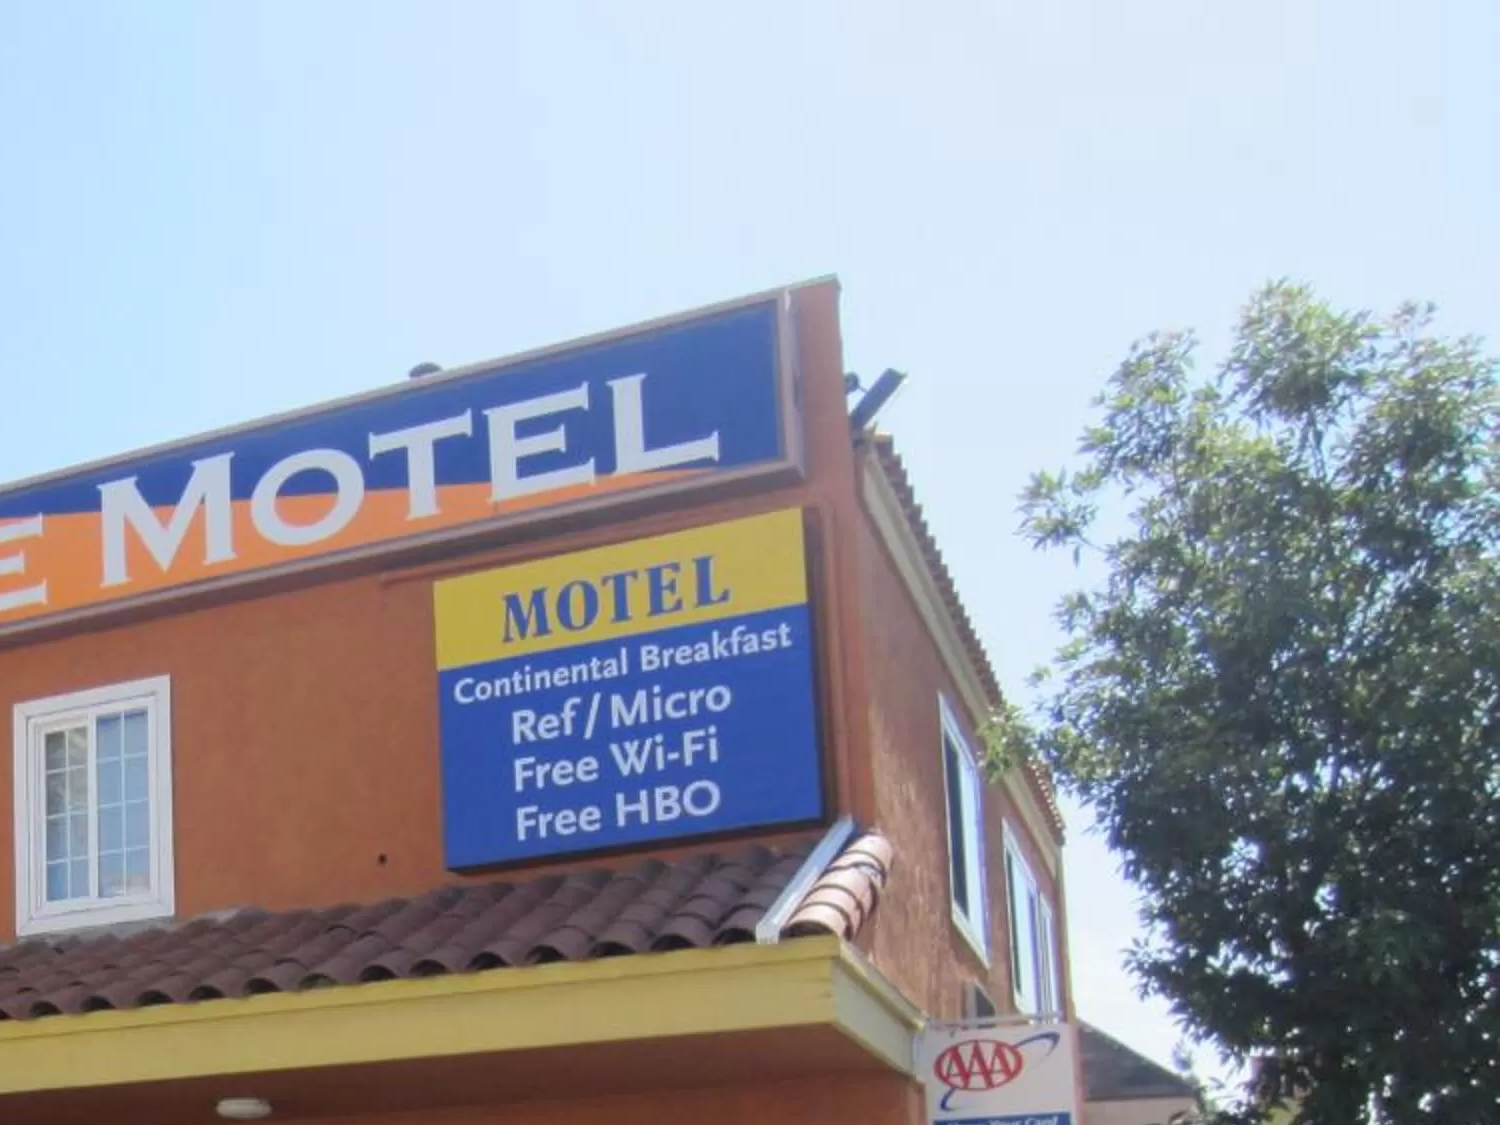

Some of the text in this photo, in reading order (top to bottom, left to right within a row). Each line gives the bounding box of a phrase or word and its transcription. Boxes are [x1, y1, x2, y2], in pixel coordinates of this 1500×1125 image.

[98, 373, 720, 588] MOTEL
[502, 555, 731, 643] MOTEL
[453, 622, 792, 704] Continental Breakfast
[514, 726, 719, 792] Free Wi-Fi
[516, 780, 721, 841] Free HBO
[943, 1040, 1015, 1089] AAA
